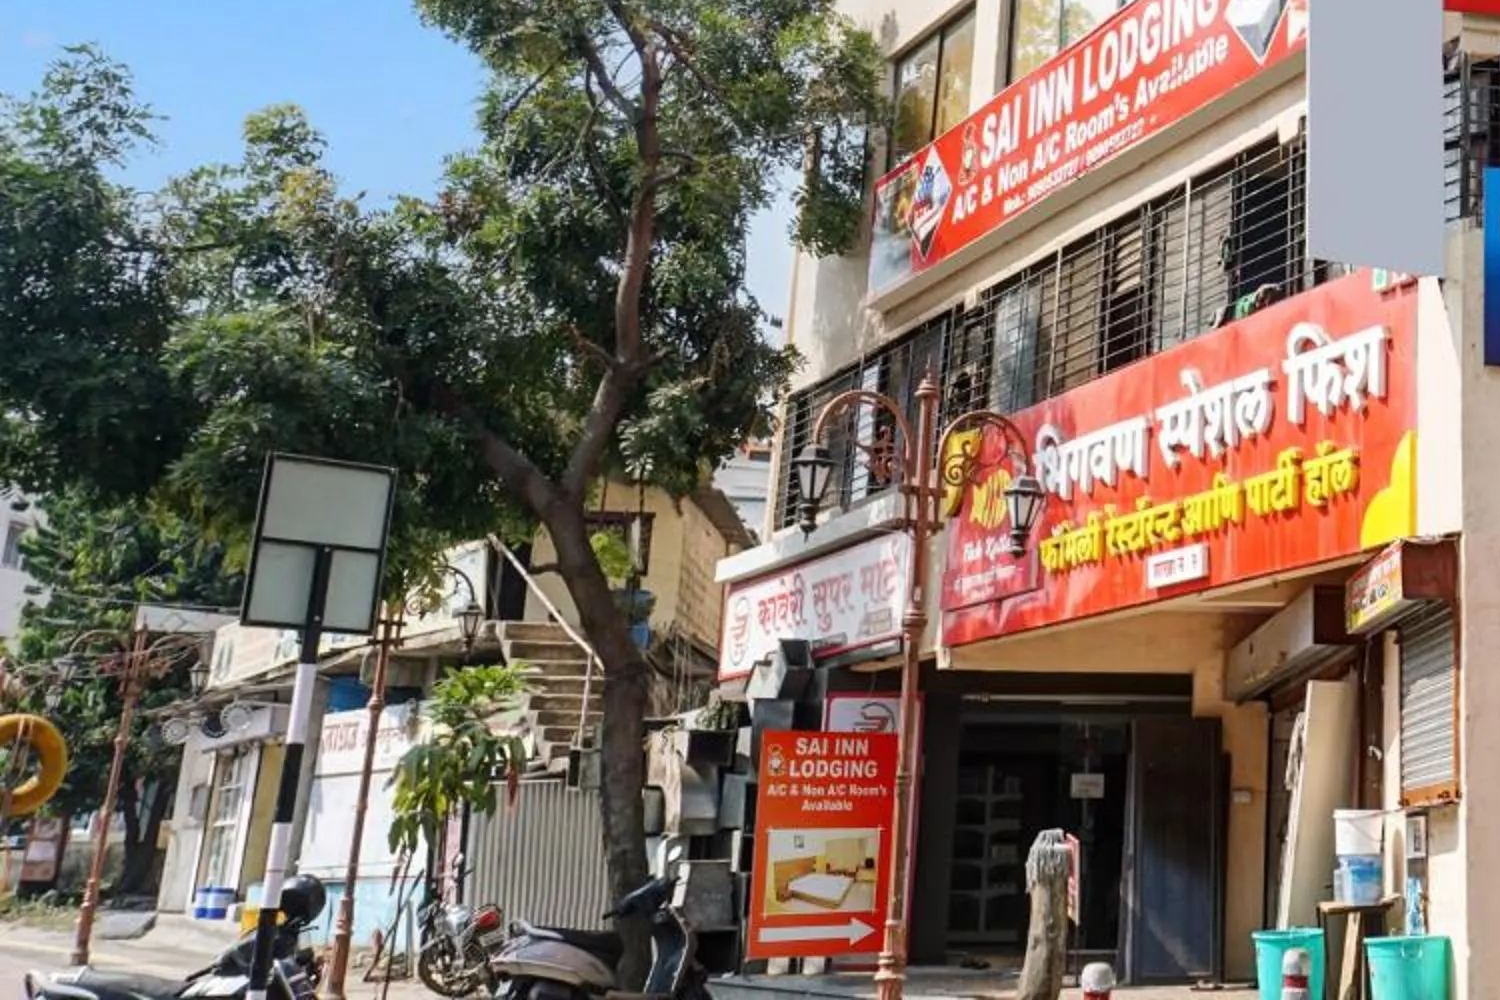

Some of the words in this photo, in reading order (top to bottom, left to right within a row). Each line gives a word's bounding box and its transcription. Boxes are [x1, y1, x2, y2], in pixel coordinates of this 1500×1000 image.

[952, 184, 977, 225] A/C
[982, 174, 993, 206] &
[1000, 158, 1029, 196] Non
[1033, 131, 1061, 175] A/C
[1065, 90, 1129, 160] Room's
[1134, 34, 1229, 110] Available
[980, 95, 1021, 168] SAI
[1027, 57, 1075, 140] INN
[1034, 423, 1150, 497] भिगवण
[1156, 367, 1276, 467] स्पेशल
[1282, 322, 1391, 424] फिश
[1181, 472, 1243, 537] आणि
[1245, 447, 1298, 516] पार्टी
[1303, 440, 1359, 507] हॉल
[757, 572, 807, 635] कावेरी
[811, 570, 855, 632] सुपर
[789, 759, 878, 778] LODGING
[796, 737, 829, 756] SAI
[835, 737, 869, 756] INN
